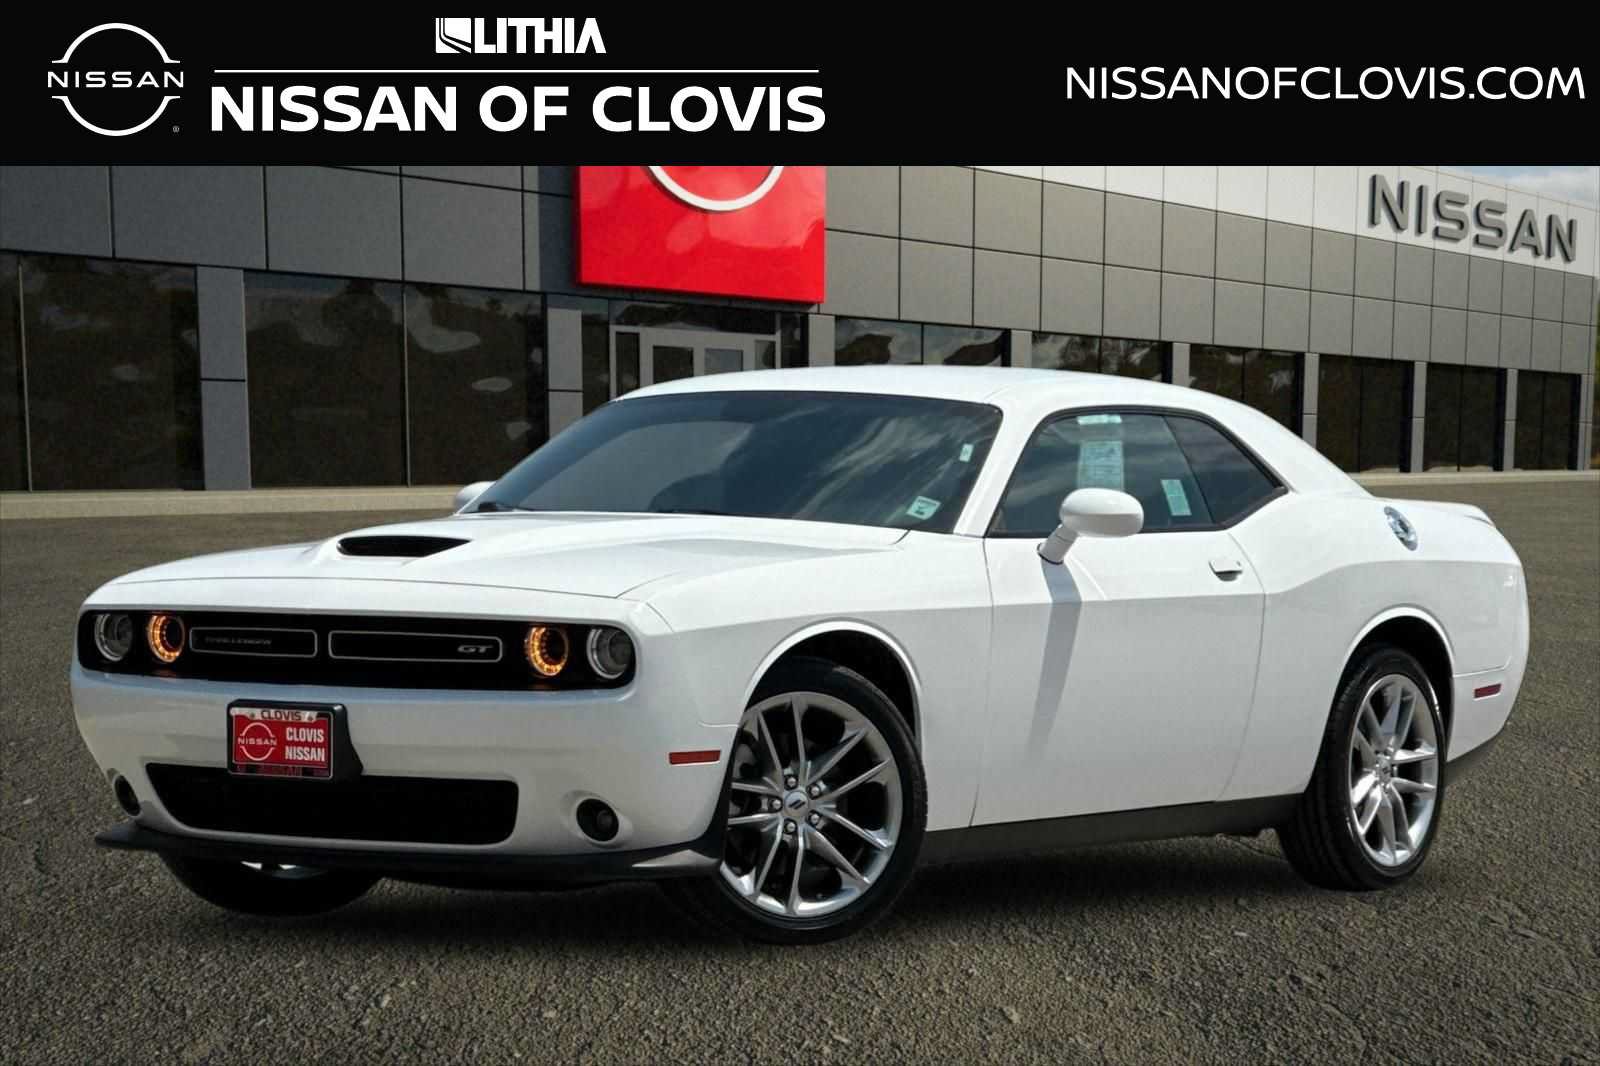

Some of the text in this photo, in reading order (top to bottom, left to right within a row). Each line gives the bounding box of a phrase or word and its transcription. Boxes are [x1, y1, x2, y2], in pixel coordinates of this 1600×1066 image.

[1368, 174, 1577, 263] NISSAN
[457, 644, 494, 653] GT
[260, 709, 302, 721] CLOVIS
[237, 737, 277, 746] NISSAN
[286, 727, 324, 743] CLOVIS
[285, 746, 325, 762] NISSAN
